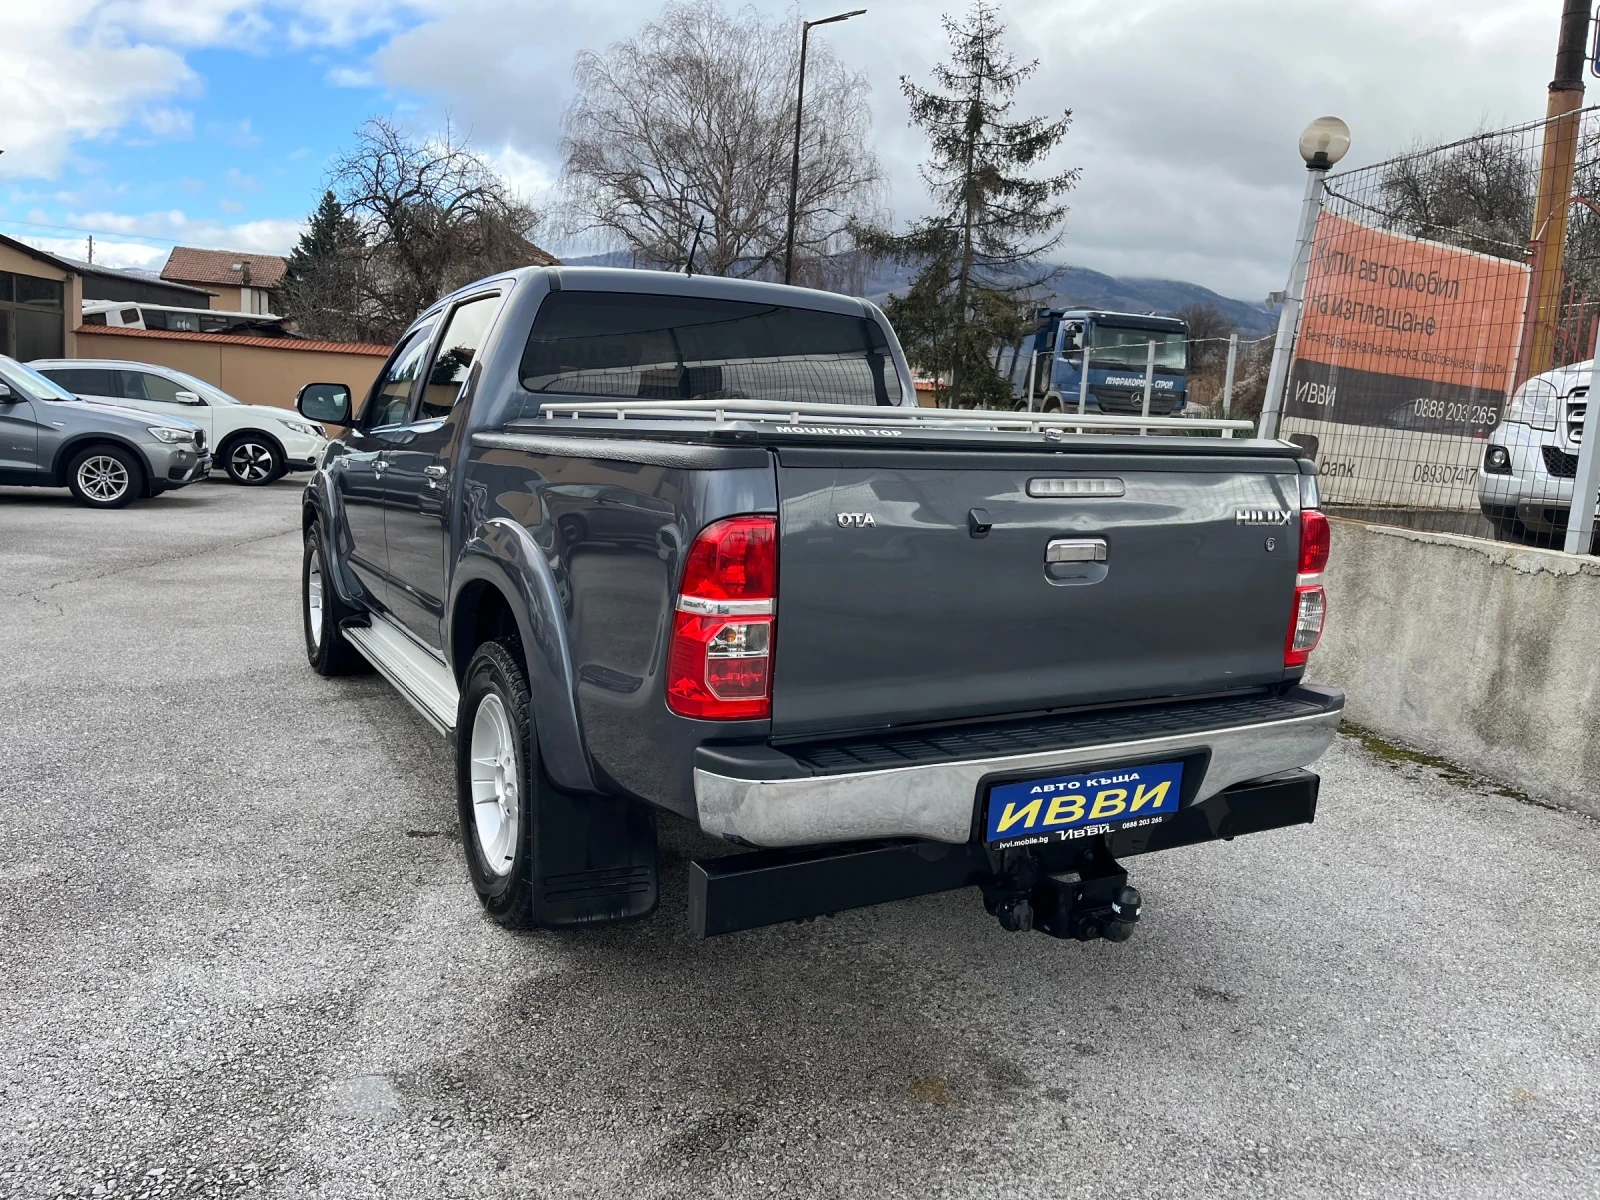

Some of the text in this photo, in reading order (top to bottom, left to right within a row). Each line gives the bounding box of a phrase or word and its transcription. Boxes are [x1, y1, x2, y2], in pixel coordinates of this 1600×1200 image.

[1358, 259, 1459, 300] автомобил
[1310, 290, 1436, 336] на изплащане
[1294, 380, 1337, 407] ИВВИ
[1414, 397, 1445, 420] 0888
[1471, 405, 1498, 426] 265
[776, 426, 903, 437] MOUNTAIN TOP
[1320, 455, 1355, 478] bank
[1235, 510, 1292, 526] HILUX
[1030, 781, 1080, 794] АВТО
[996, 781, 1172, 833] ИВВИ
